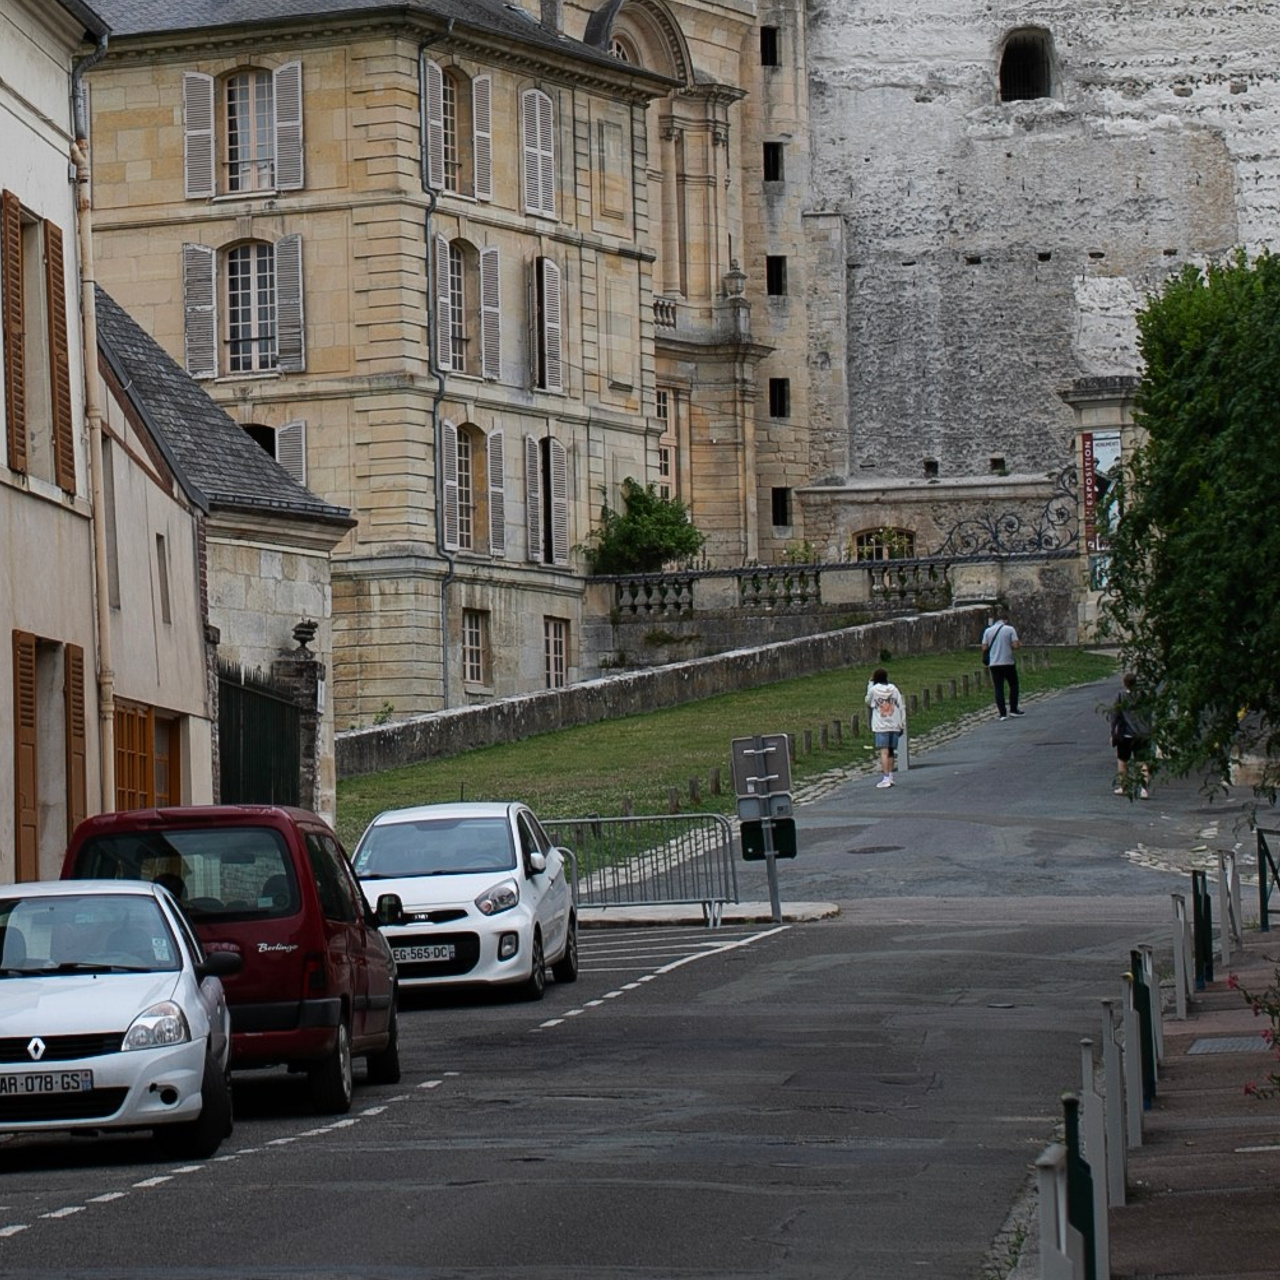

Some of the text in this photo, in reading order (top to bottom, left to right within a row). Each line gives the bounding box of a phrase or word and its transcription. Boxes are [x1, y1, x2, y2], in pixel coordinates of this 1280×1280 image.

[1084, 440, 1093, 507] EXPOSITION
[257, 942, 299, 953] Berlingo
[0, 1073, 81, 1094] AR-078-GS
